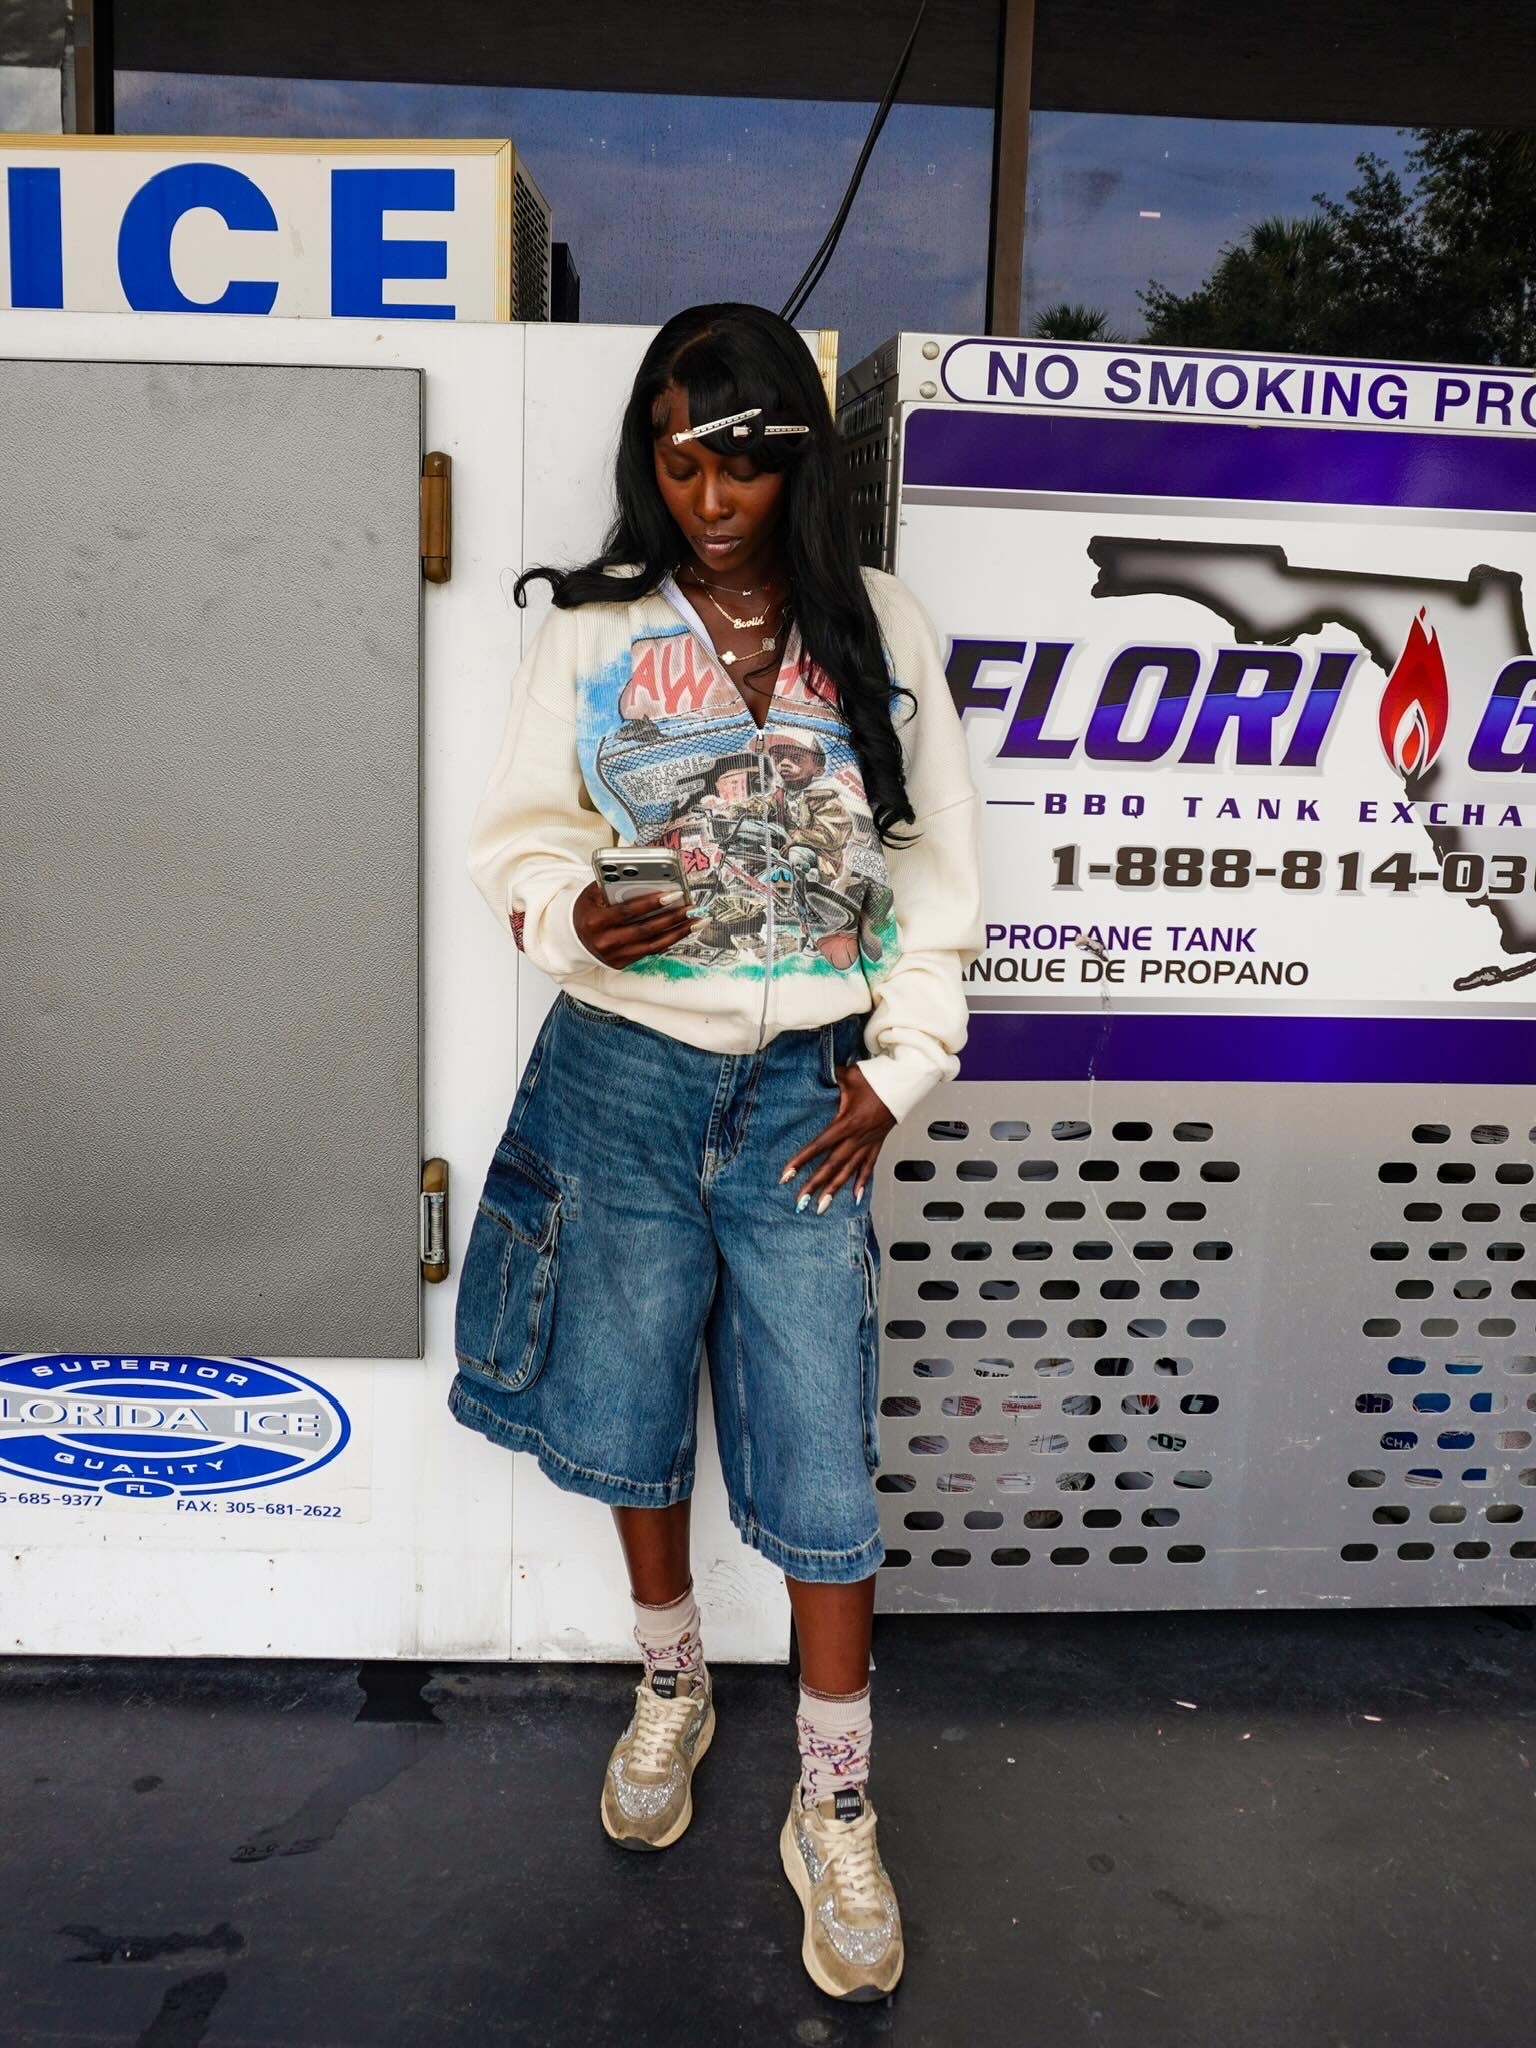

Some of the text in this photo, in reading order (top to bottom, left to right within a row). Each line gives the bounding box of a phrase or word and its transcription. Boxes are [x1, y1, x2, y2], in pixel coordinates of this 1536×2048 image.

[7, 162, 456, 320] ICE
[986, 351, 1078, 400] NO
[1104, 358, 1408, 421] SMOKING
[945, 637, 1364, 771] FLORI
[1043, 793, 1523, 827] BBQ TANK EXCHA
[1051, 843, 1536, 895] 1-888-814-03
[985, 924, 1257, 952] PROPANE TANK
[1081, 959, 1125, 983] DE
[1140, 960, 1309, 986] PROPANO
[32, 1359, 249, 1387] SUPERIOR
[234, 1410, 321, 1438] ICE
[54, 1452, 225, 1475] QUALITY
[126, 1484, 152, 1495] FL
[176, 1500, 218, 1513] FAX:
[225, 1501, 342, 1518] 305-681-2622
